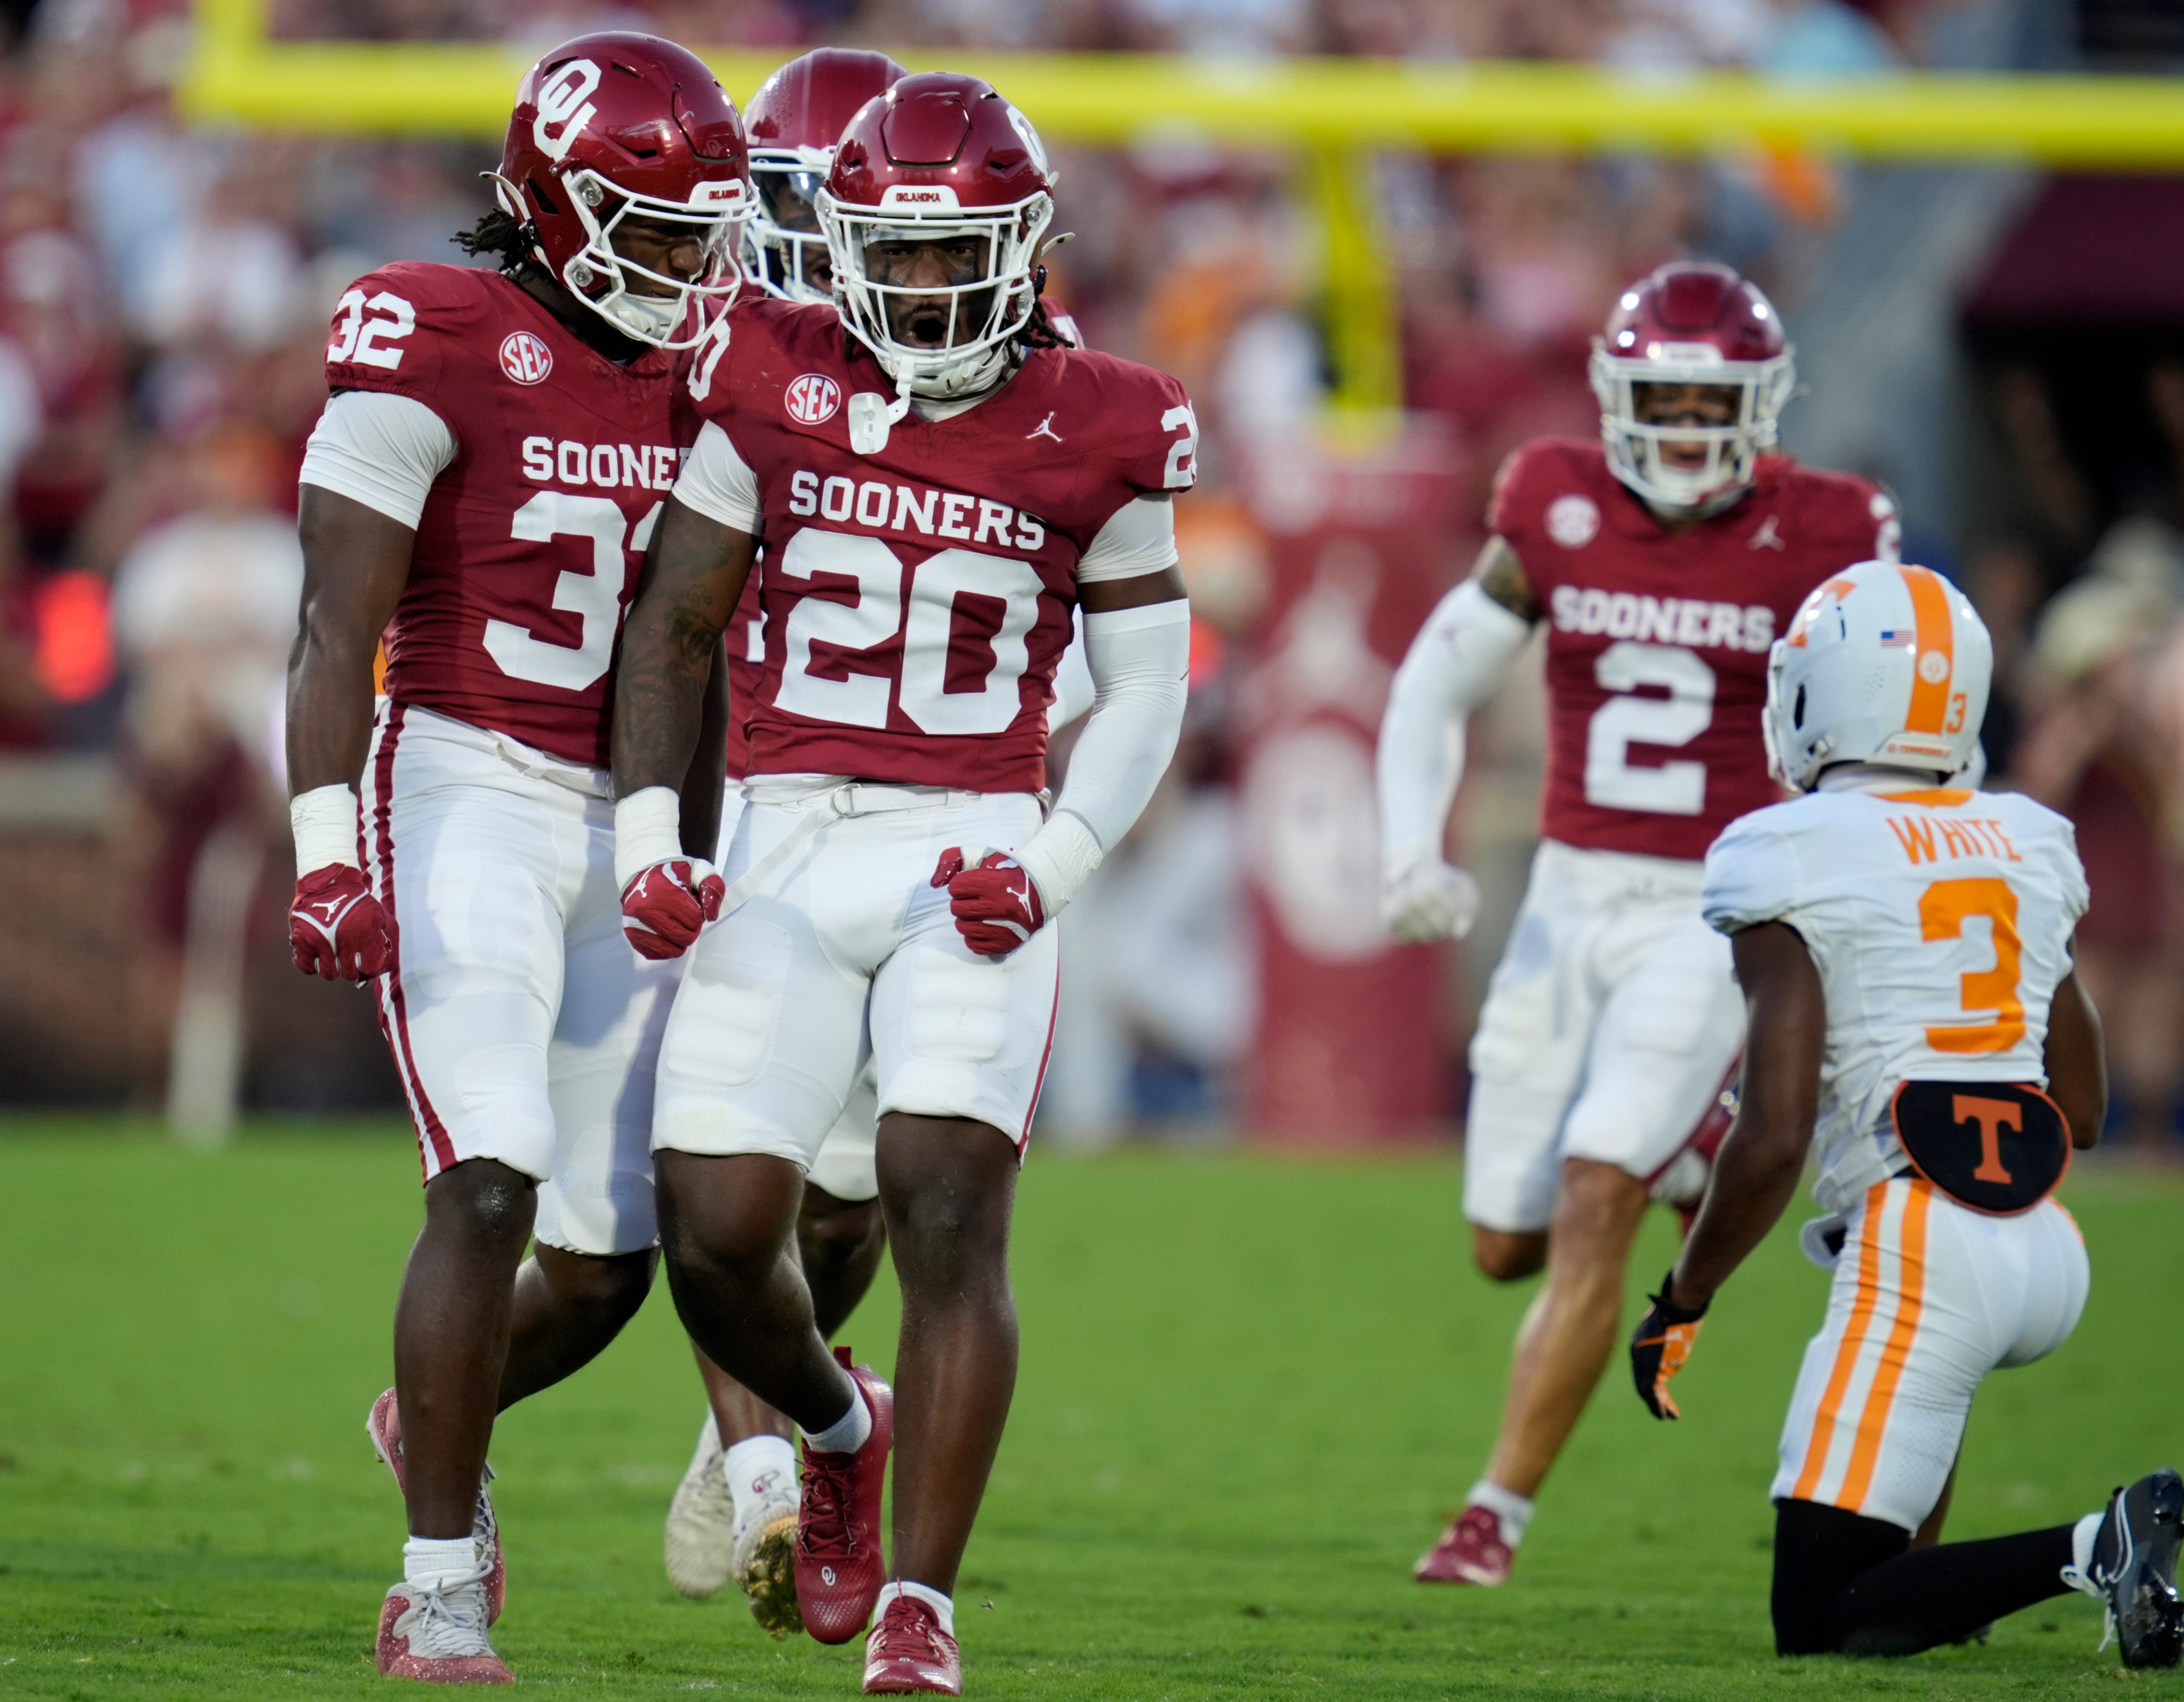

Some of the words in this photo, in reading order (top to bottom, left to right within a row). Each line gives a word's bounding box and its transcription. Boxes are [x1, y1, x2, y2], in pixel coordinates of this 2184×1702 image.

[533, 59, 601, 158] OU
[896, 193, 941, 202] OKLAHOMA
[327, 290, 416, 370] 32
[504, 335, 549, 381] SEC
[791, 377, 836, 421] SEC
[523, 436, 692, 490] SOONE
[1161, 399, 1199, 488] 2
[789, 470, 1046, 550] SOONERS
[483, 491, 663, 691] 3
[1551, 585, 1776, 652] SOONERS
[772, 528, 1046, 735] 20
[1585, 640, 1717, 816] 2
[1947, 692, 1966, 734] 3
[1886, 816, 2022, 865] WHITE
[1918, 878, 2026, 1053] 3
[1952, 1094, 2022, 1184] T
[822, 1566, 836, 1586] OU
